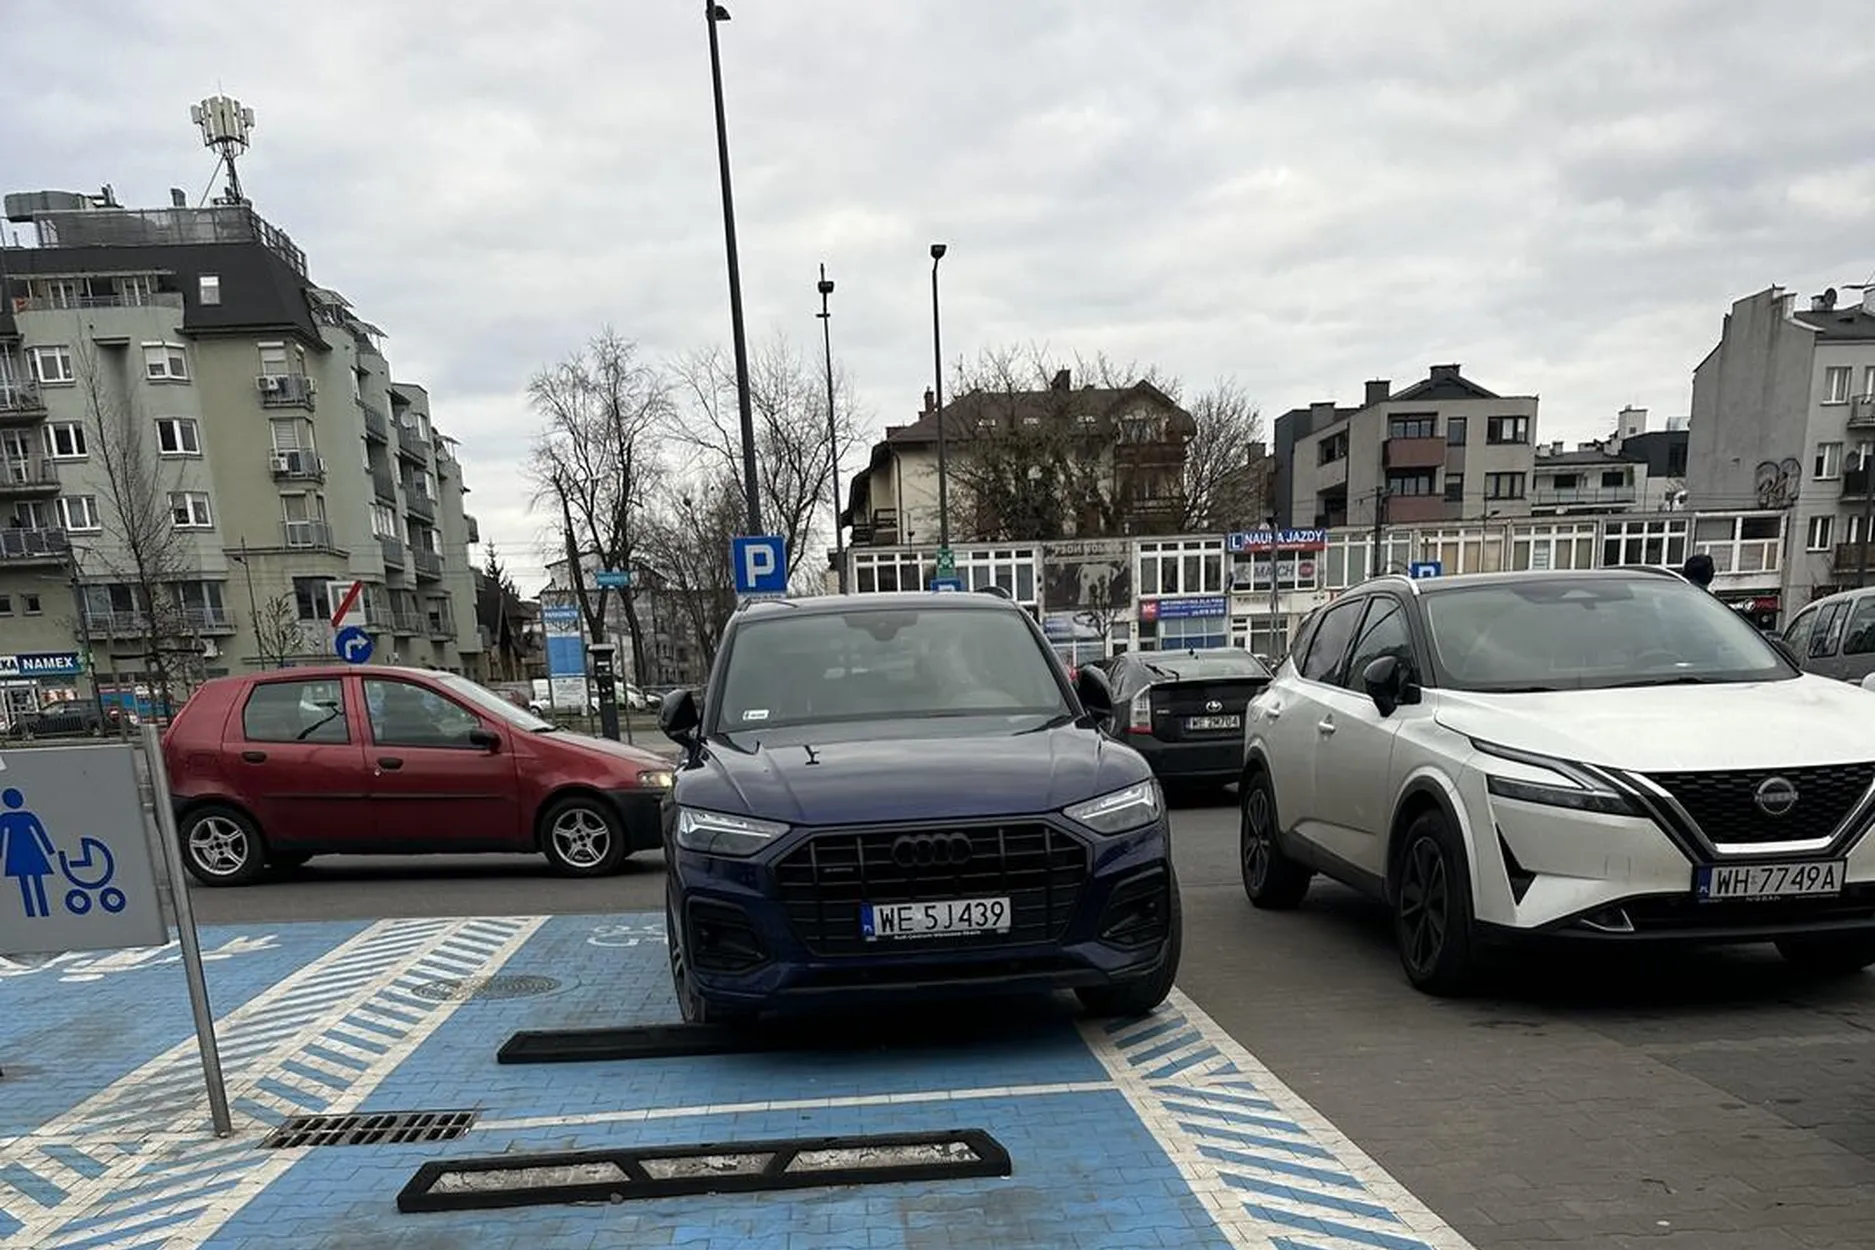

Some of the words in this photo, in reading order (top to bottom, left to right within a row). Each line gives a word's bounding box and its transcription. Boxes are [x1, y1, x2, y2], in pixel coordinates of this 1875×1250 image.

[1286, 530, 1323, 542] JAZDY
[745, 544, 775, 587] P
[0, 659, 17, 670] KA
[23, 657, 74, 669] NAMEX
[1716, 868, 1750, 894] WH
[1758, 864, 1835, 893] 7749A
[879, 906, 914, 932] WE
[924, 901, 1005, 930] 5J439
